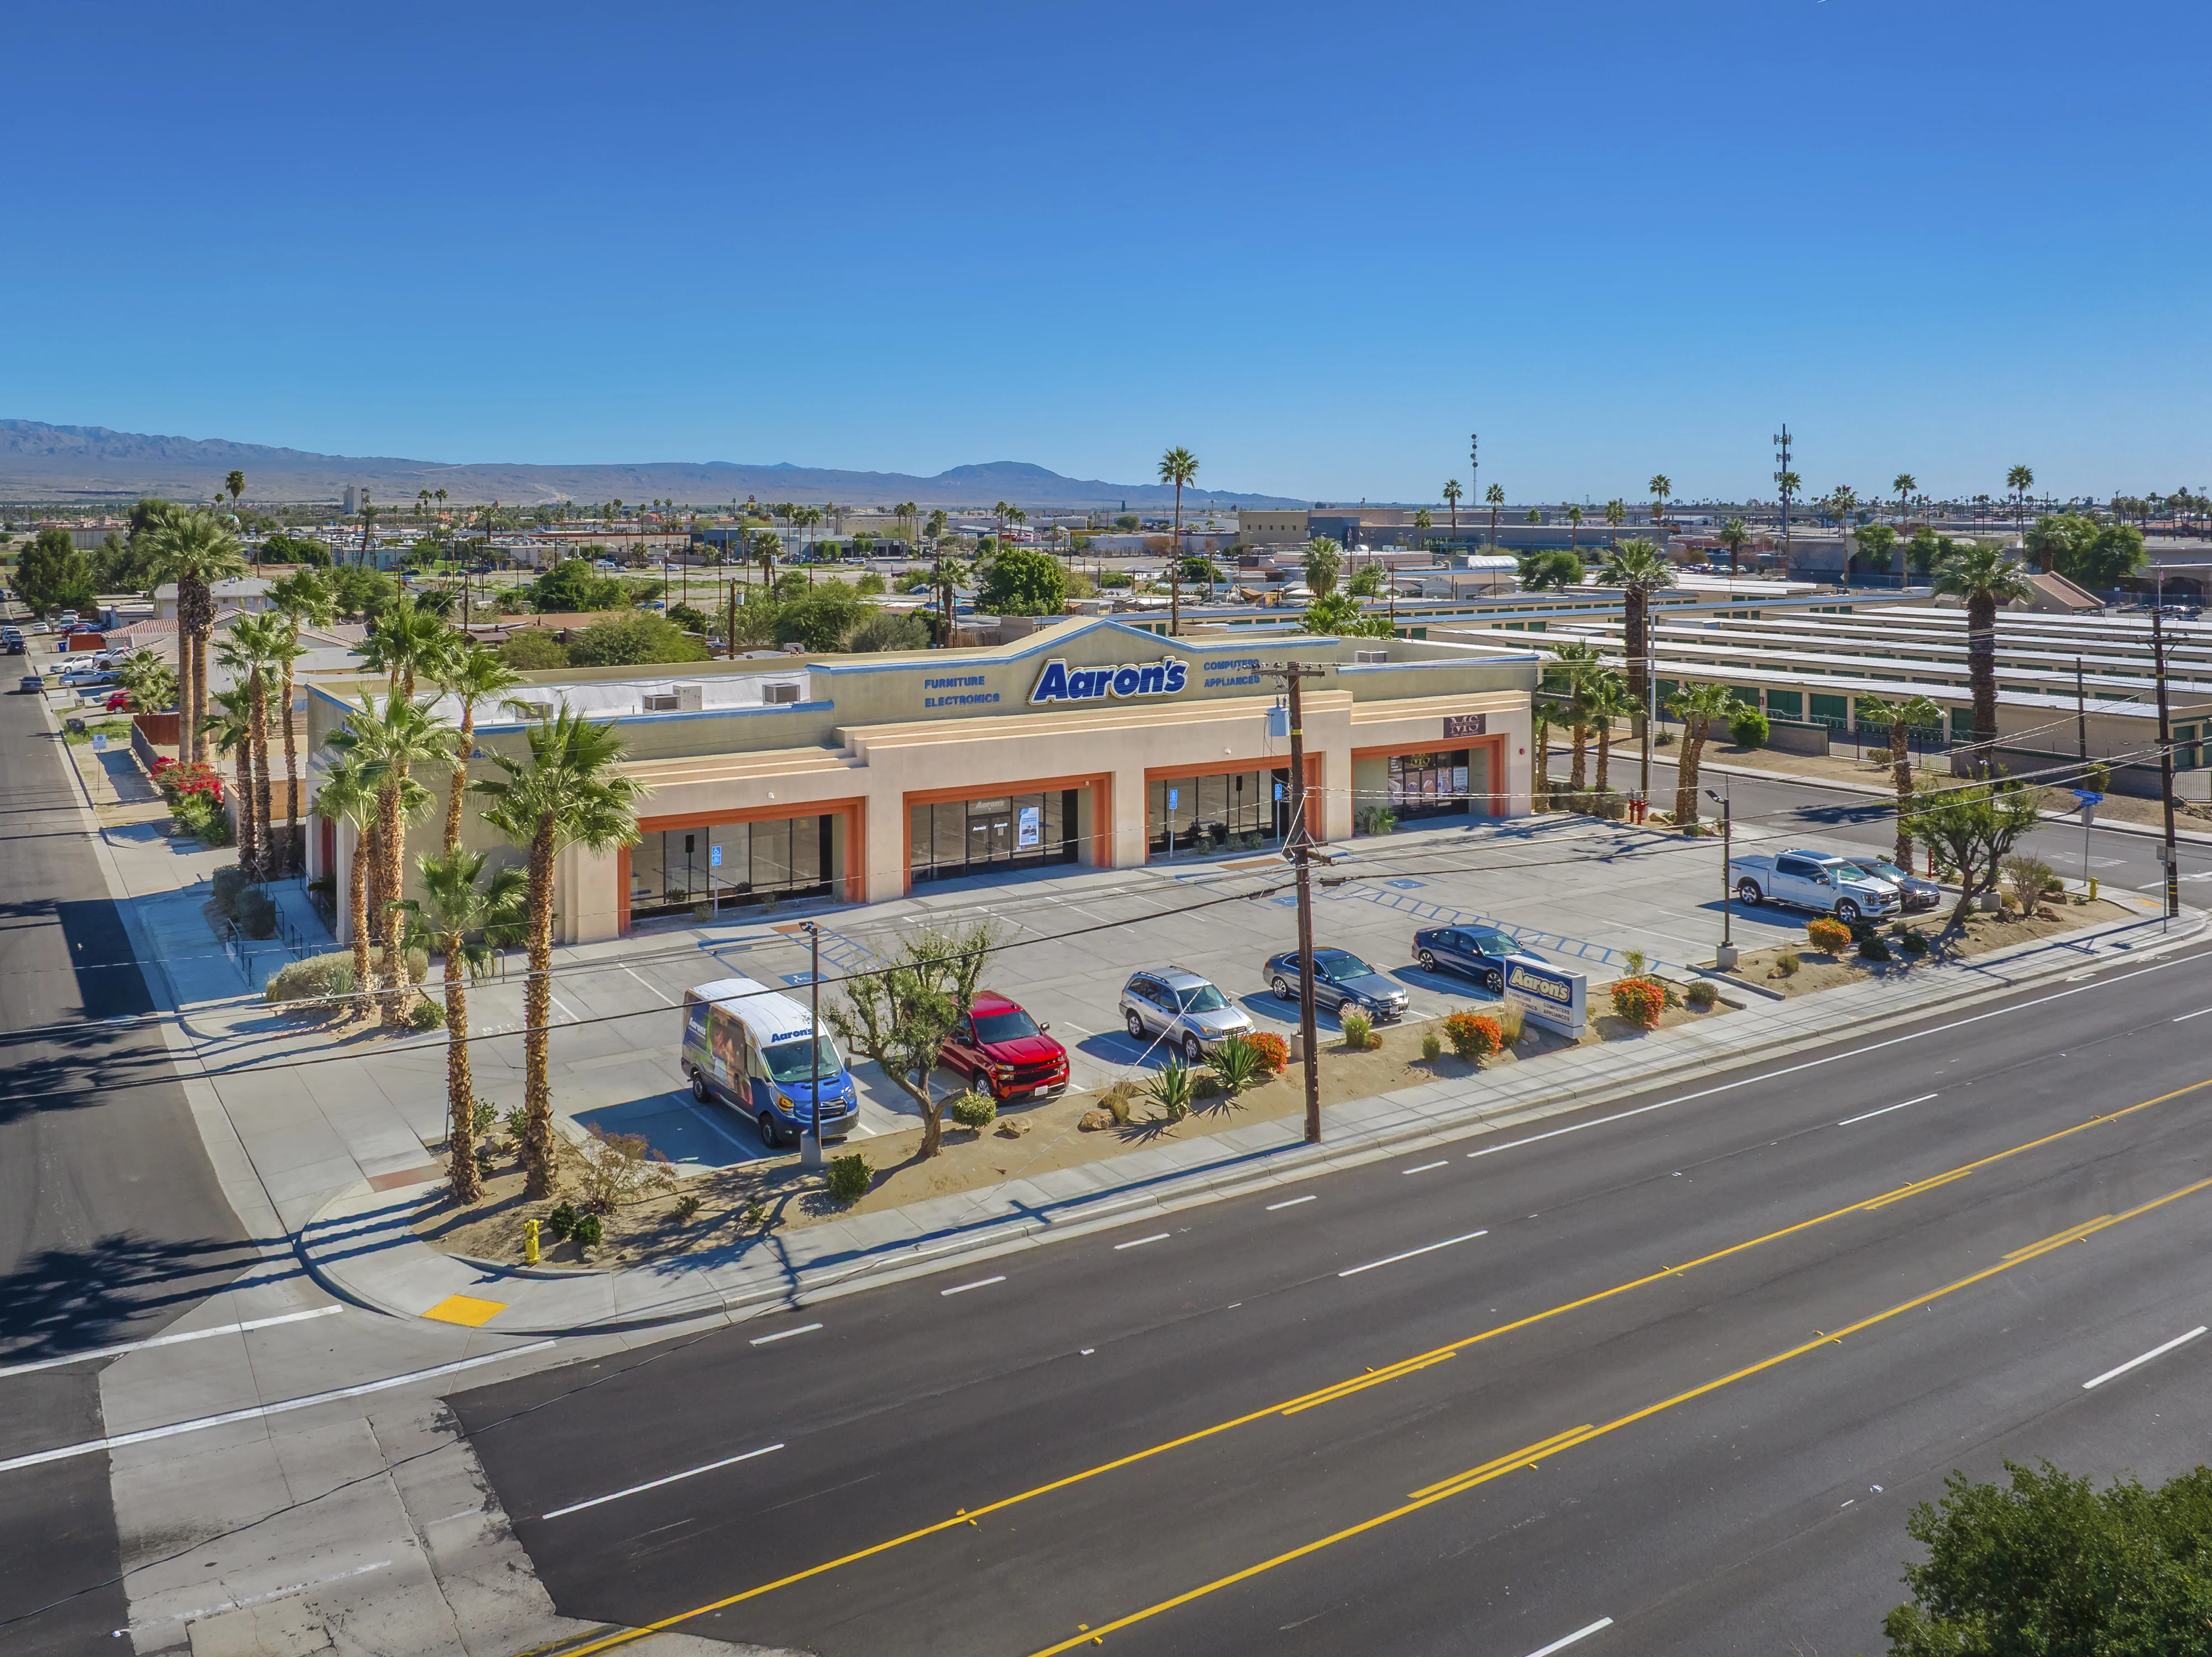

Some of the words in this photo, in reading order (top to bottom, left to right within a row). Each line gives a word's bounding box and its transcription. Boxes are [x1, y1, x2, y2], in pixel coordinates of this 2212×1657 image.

[925, 676, 985, 689] FURNITURE
[1030, 656, 1188, 702] Aaron's
[1204, 675, 1260, 687] APPLIANCES
[925, 693, 1000, 707] ELECTRONICS
[1510, 967, 1569, 1001] Aaron's
[1509, 991, 1531, 1002] FURNITURE
[1543, 1003, 1570, 1014] COMPUTERS
[1543, 1009, 1570, 1022] APPLIANCES
[771, 1028, 812, 1043] Aaron's
